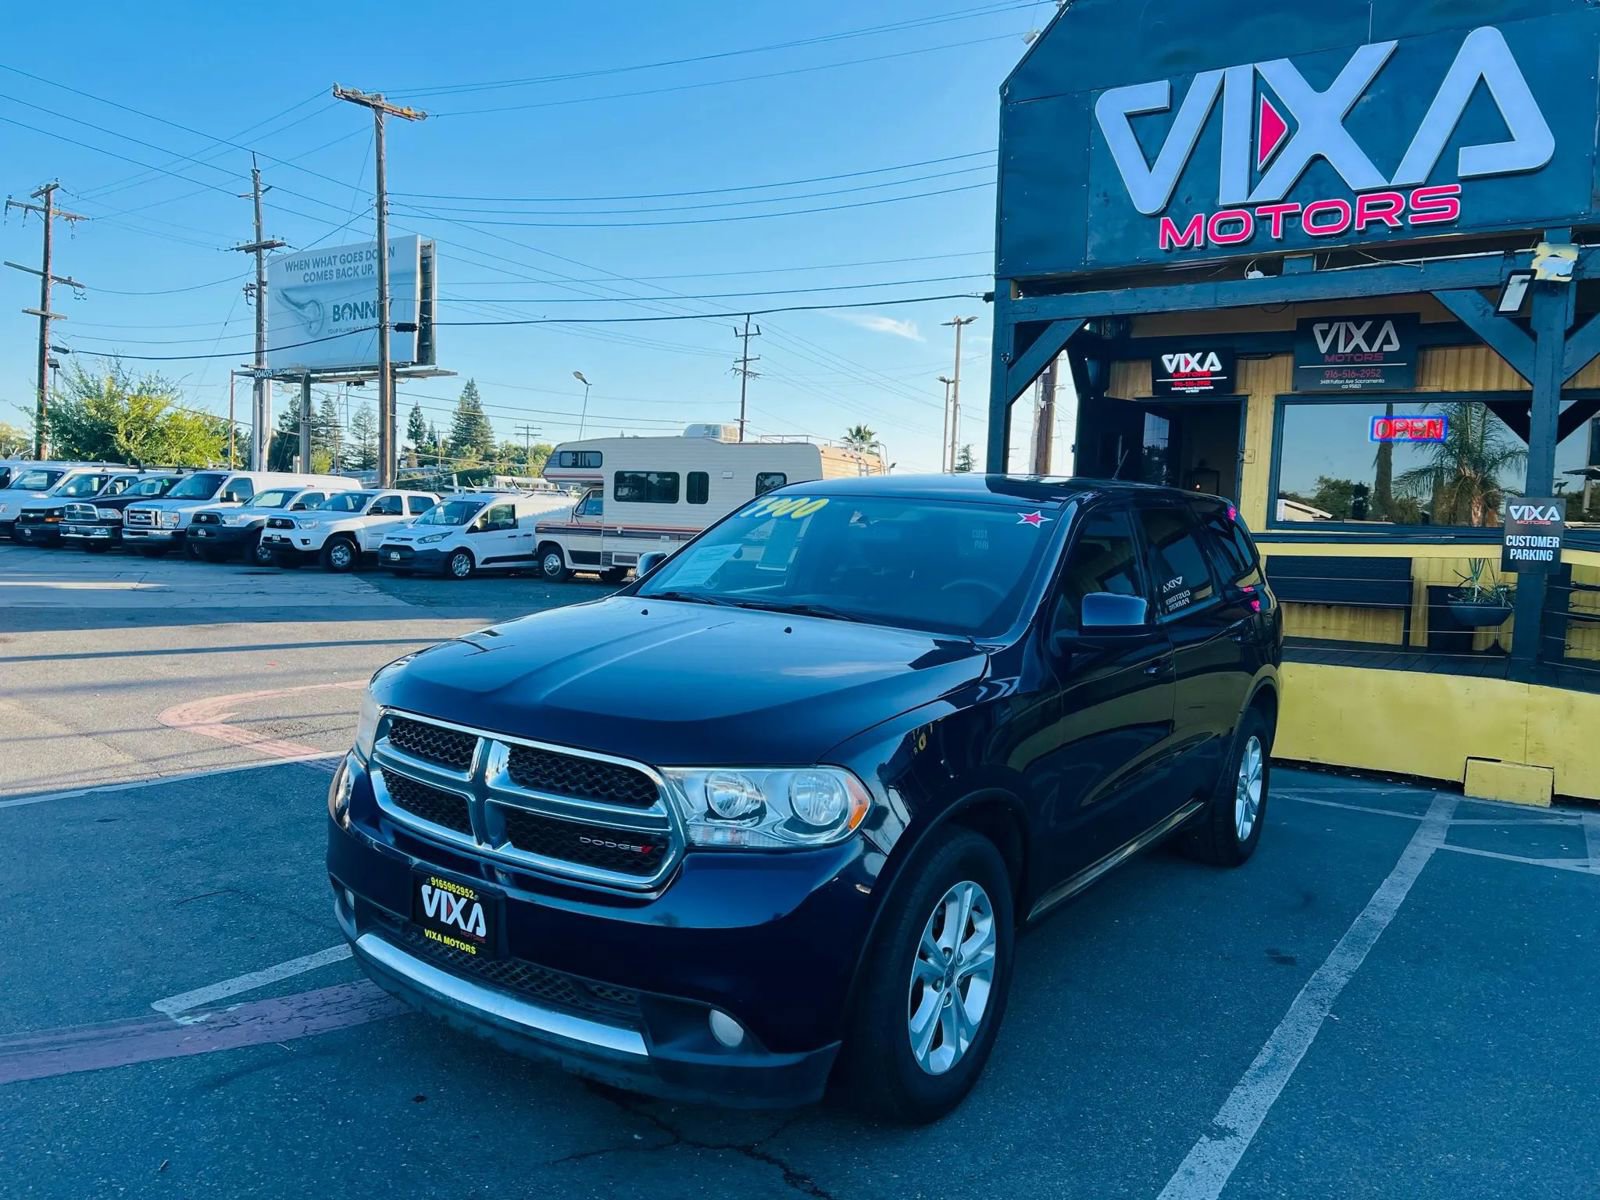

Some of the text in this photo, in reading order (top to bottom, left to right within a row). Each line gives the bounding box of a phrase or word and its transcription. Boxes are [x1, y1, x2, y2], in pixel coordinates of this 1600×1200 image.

[1095, 25, 1556, 215] VIXA
[1158, 183, 1463, 250] MOTORS
[285, 246, 395, 272] WHEN WHAT GOES DON
[303, 263, 374, 283] COMES BACK UP.
[1313, 320, 1400, 354] VIXA
[1161, 351, 1222, 373] VIXA
[1324, 352, 1384, 363] MOTORS
[1375, 418, 1443, 439] OPEN
[1509, 505, 1560, 521] VIXA
[1506, 535, 1560, 548] CUSTOMER
[1510, 549, 1553, 561] PARKING
[579, 836, 643, 853] DODGE
[421, 884, 486, 937] VIXA
[424, 928, 477, 955] VIXA MOTORS
